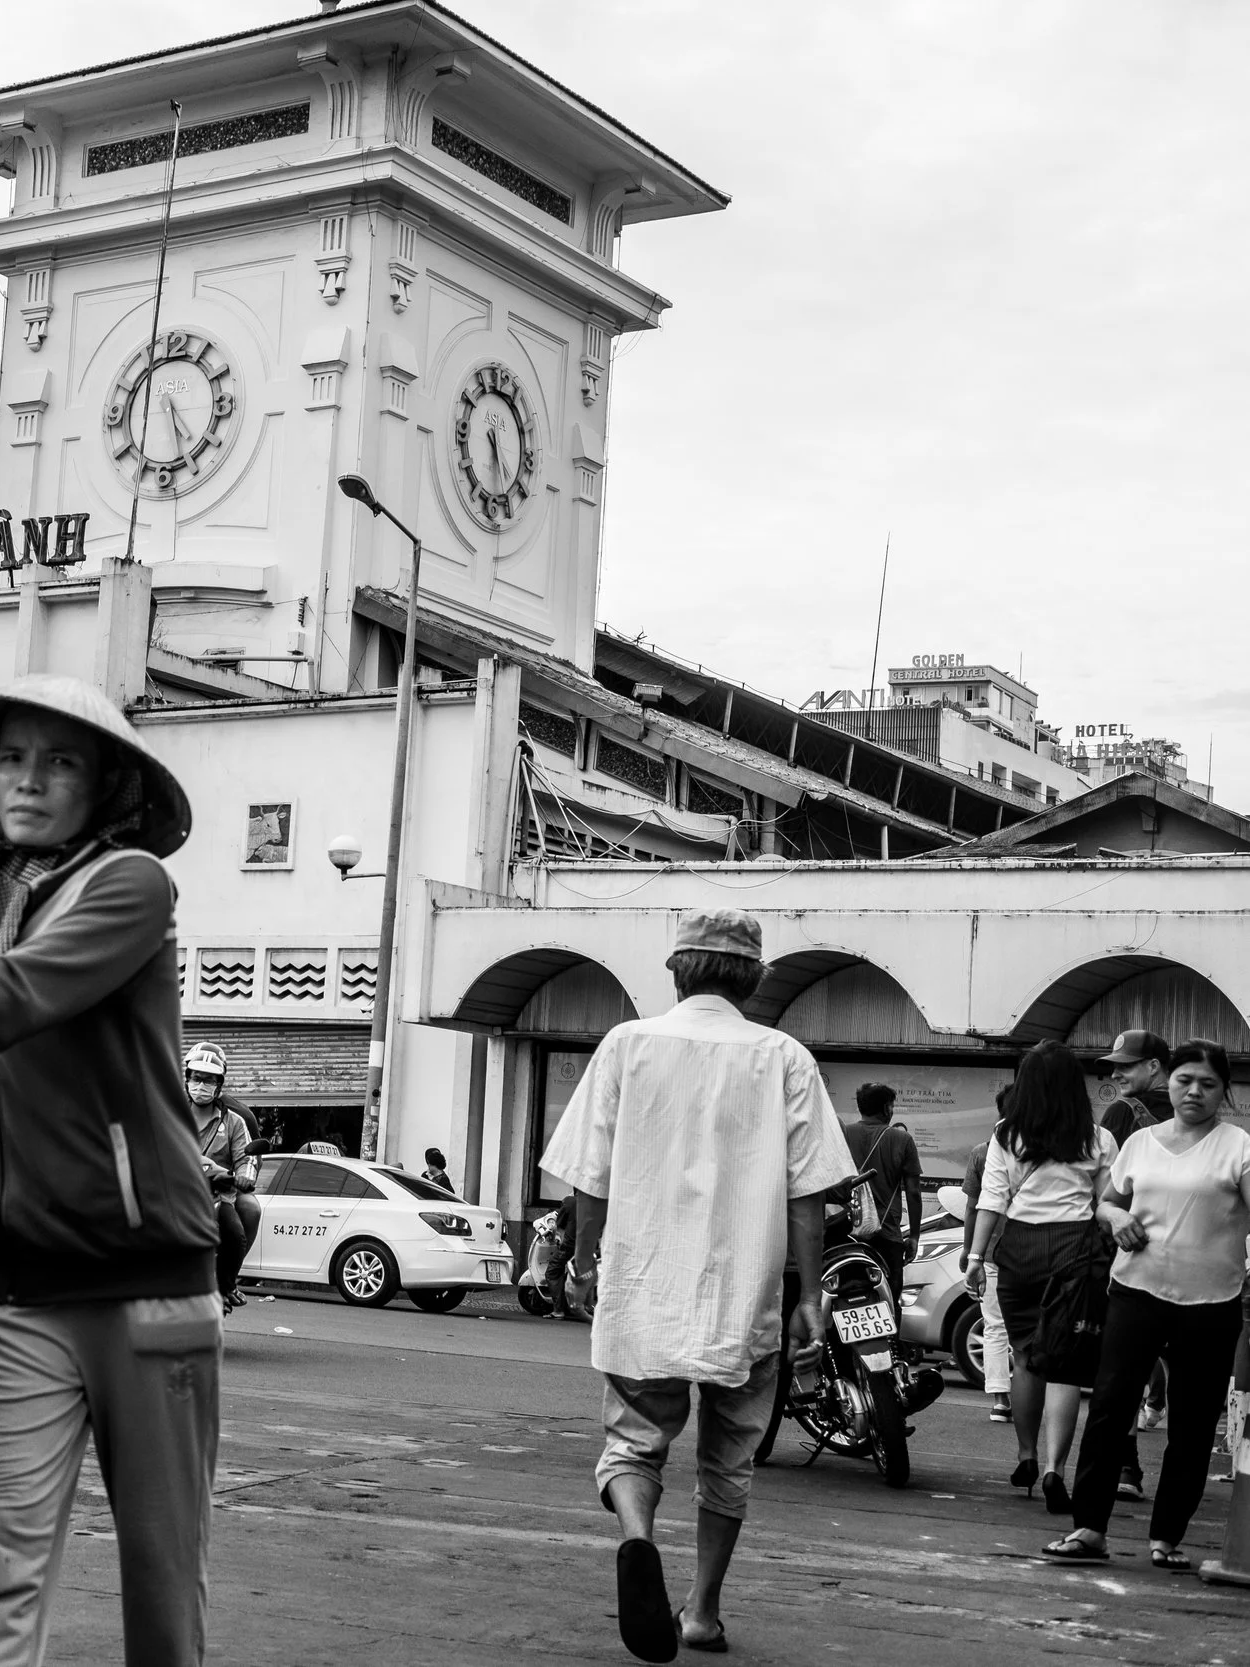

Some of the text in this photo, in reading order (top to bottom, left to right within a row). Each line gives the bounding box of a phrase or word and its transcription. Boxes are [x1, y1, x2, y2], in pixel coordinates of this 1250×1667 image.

[158, 332, 189, 359] 12
[155, 379, 191, 397] ASIA
[484, 410, 507, 432] ASIA
[912, 653, 965, 668] GOLDEN
[892, 668, 986, 680] CENTRAL HOTEL
[799, 688, 928, 710] AVANTI HOTEL
[1075, 724, 1128, 737] HOTEL
[273, 1225, 327, 1236] 54.27 27 27
[842, 1319, 893, 1341] 705.65
